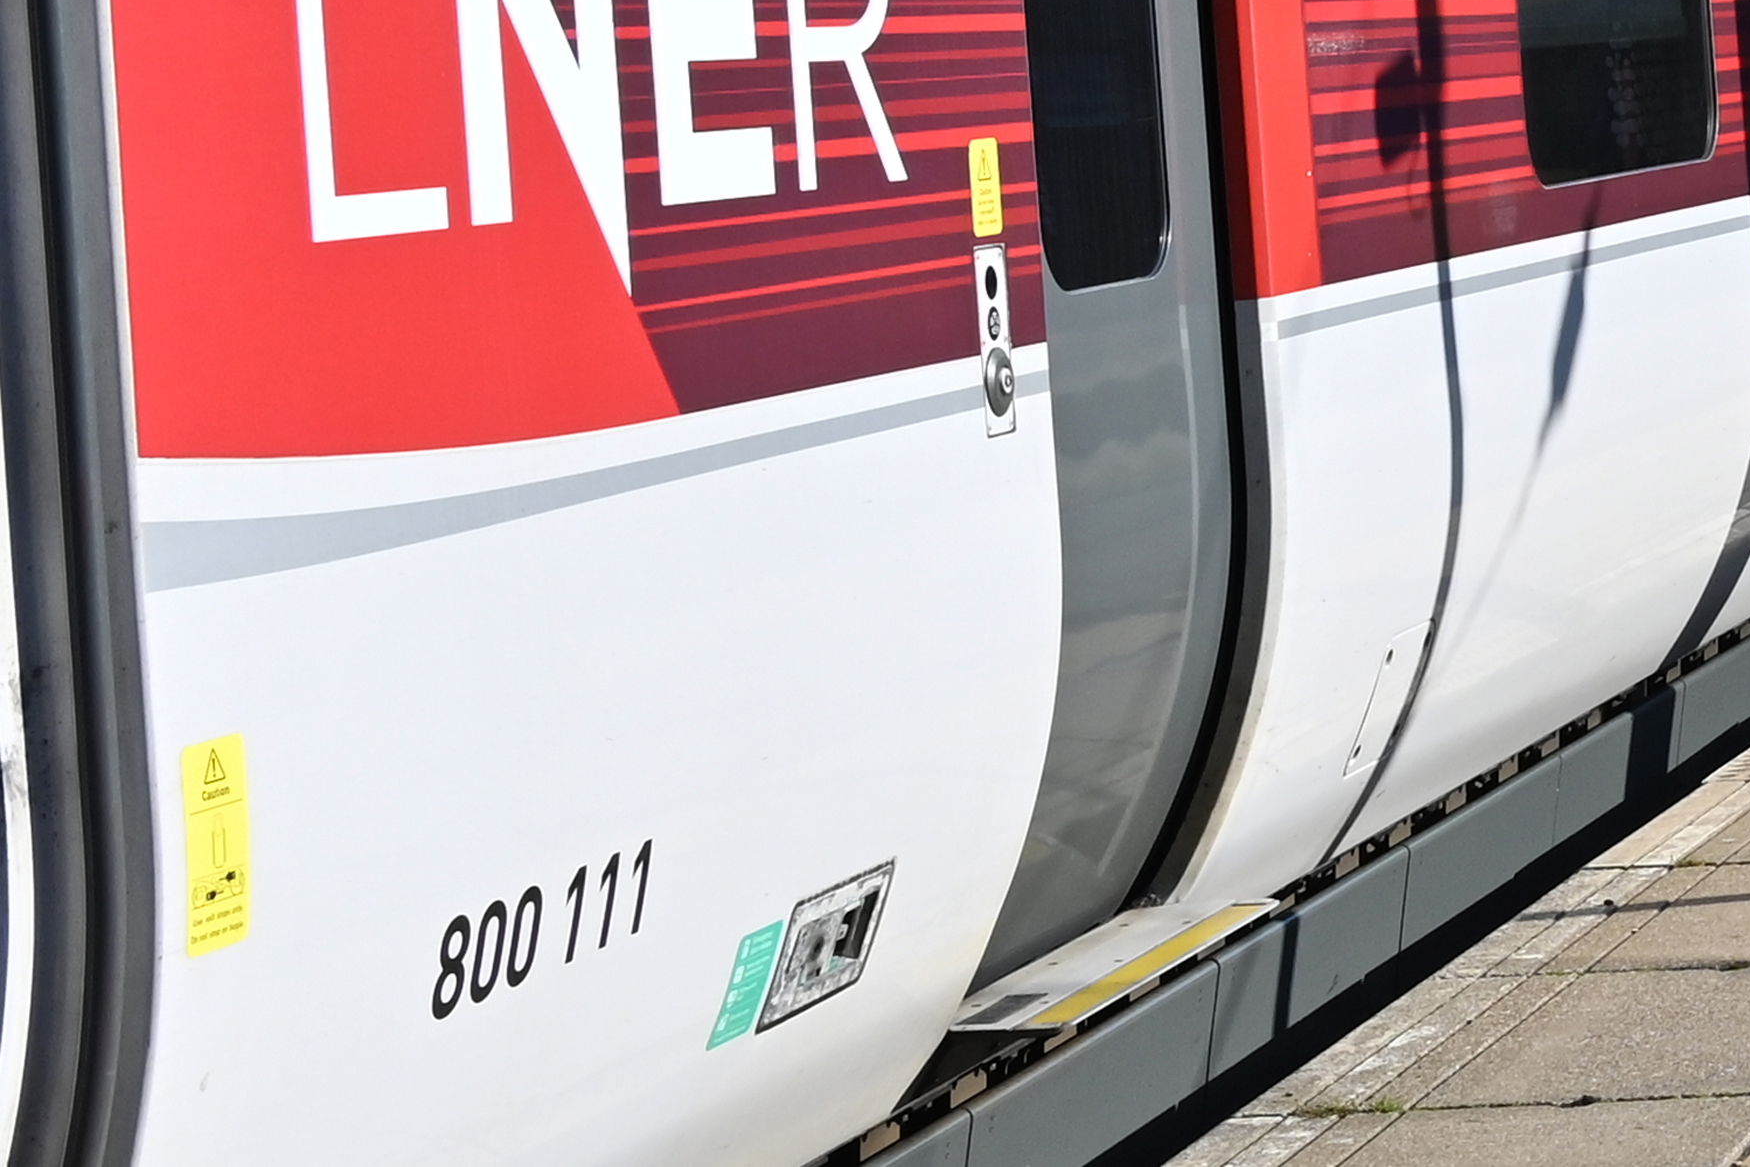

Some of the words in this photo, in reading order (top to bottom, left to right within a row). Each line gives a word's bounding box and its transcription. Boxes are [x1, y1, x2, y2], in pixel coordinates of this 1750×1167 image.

[201, 786, 231, 802] Caution
[432, 886, 543, 1021] 800
[564, 838, 653, 965] 111
